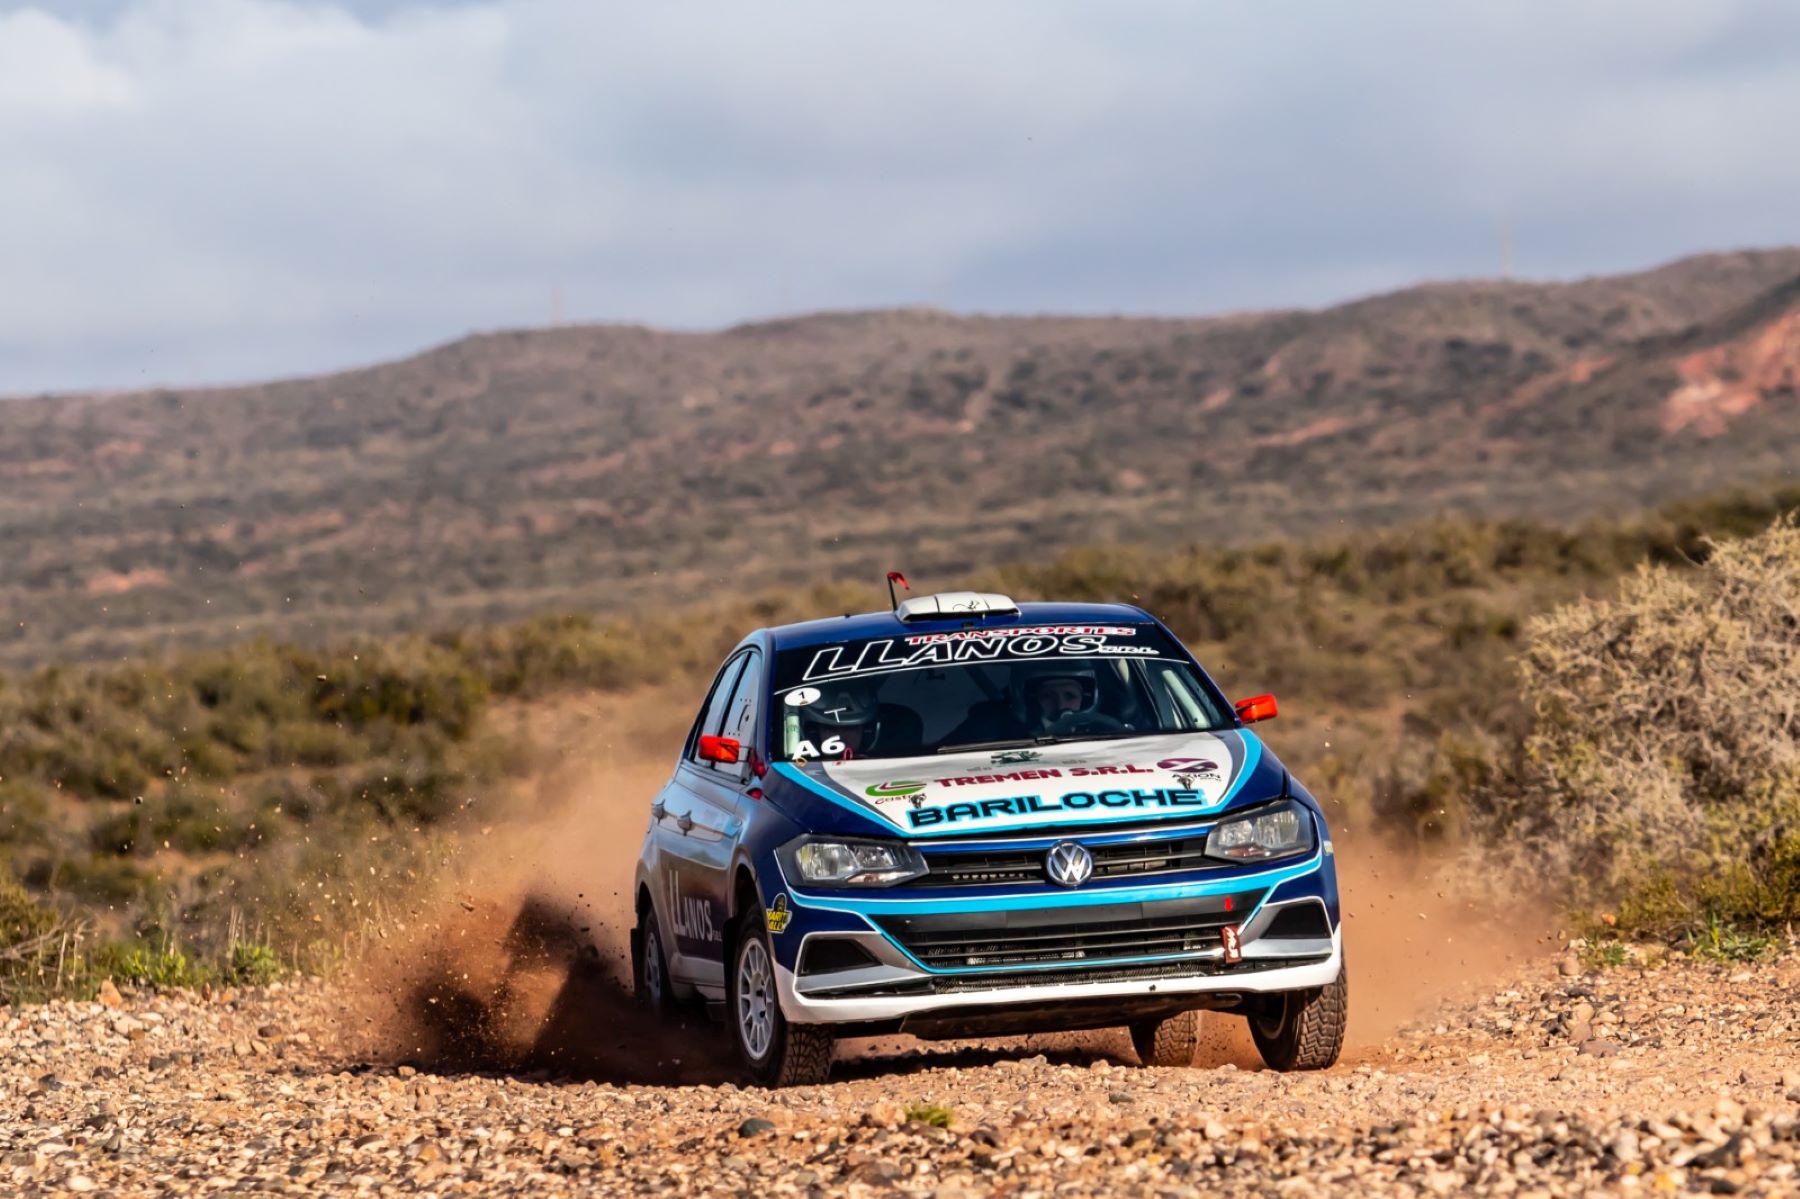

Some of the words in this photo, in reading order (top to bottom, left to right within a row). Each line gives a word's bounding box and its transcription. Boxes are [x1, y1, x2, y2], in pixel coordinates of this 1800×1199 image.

[904, 626, 1136, 646] TRANSPORTES
[802, 634, 1107, 681] LLANOS
[798, 691, 805, 699] 1
[791, 735, 846, 760] A6
[933, 768, 1062, 788] TREMEN
[1069, 764, 1154, 777] S.R.L.
[908, 788, 1203, 829] BARILOCHE
[668, 869, 713, 942] LLANOS
